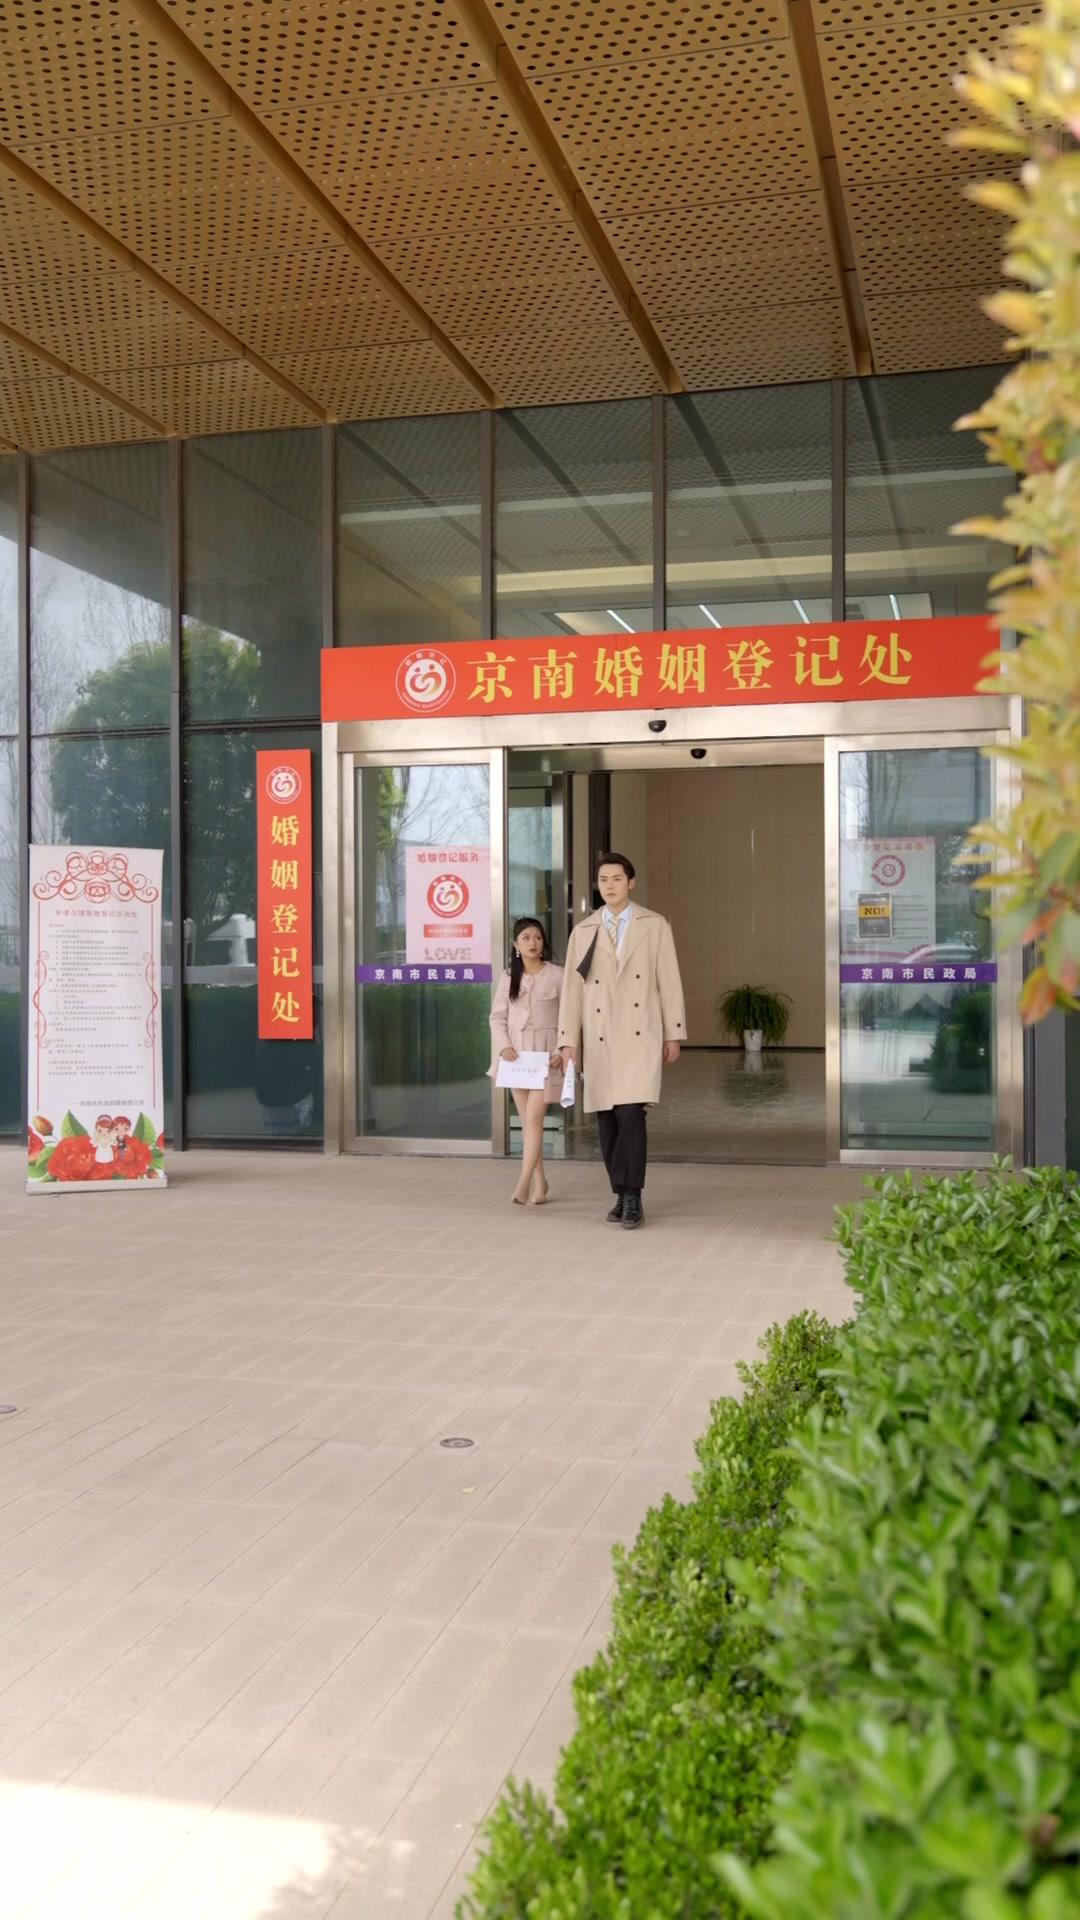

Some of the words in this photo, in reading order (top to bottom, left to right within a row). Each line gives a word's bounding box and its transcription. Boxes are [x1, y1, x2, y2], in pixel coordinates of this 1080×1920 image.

[467, 633, 913, 702] 京南婚姻登记处
[417, 852, 480, 863] 婚姻登记服务
[270, 815, 300, 1023] 婚姻登记处
[424, 947, 472, 961] LOVE
[374, 968, 475, 980] 京南市民政局
[861, 967, 977, 980] 京南市民政局
